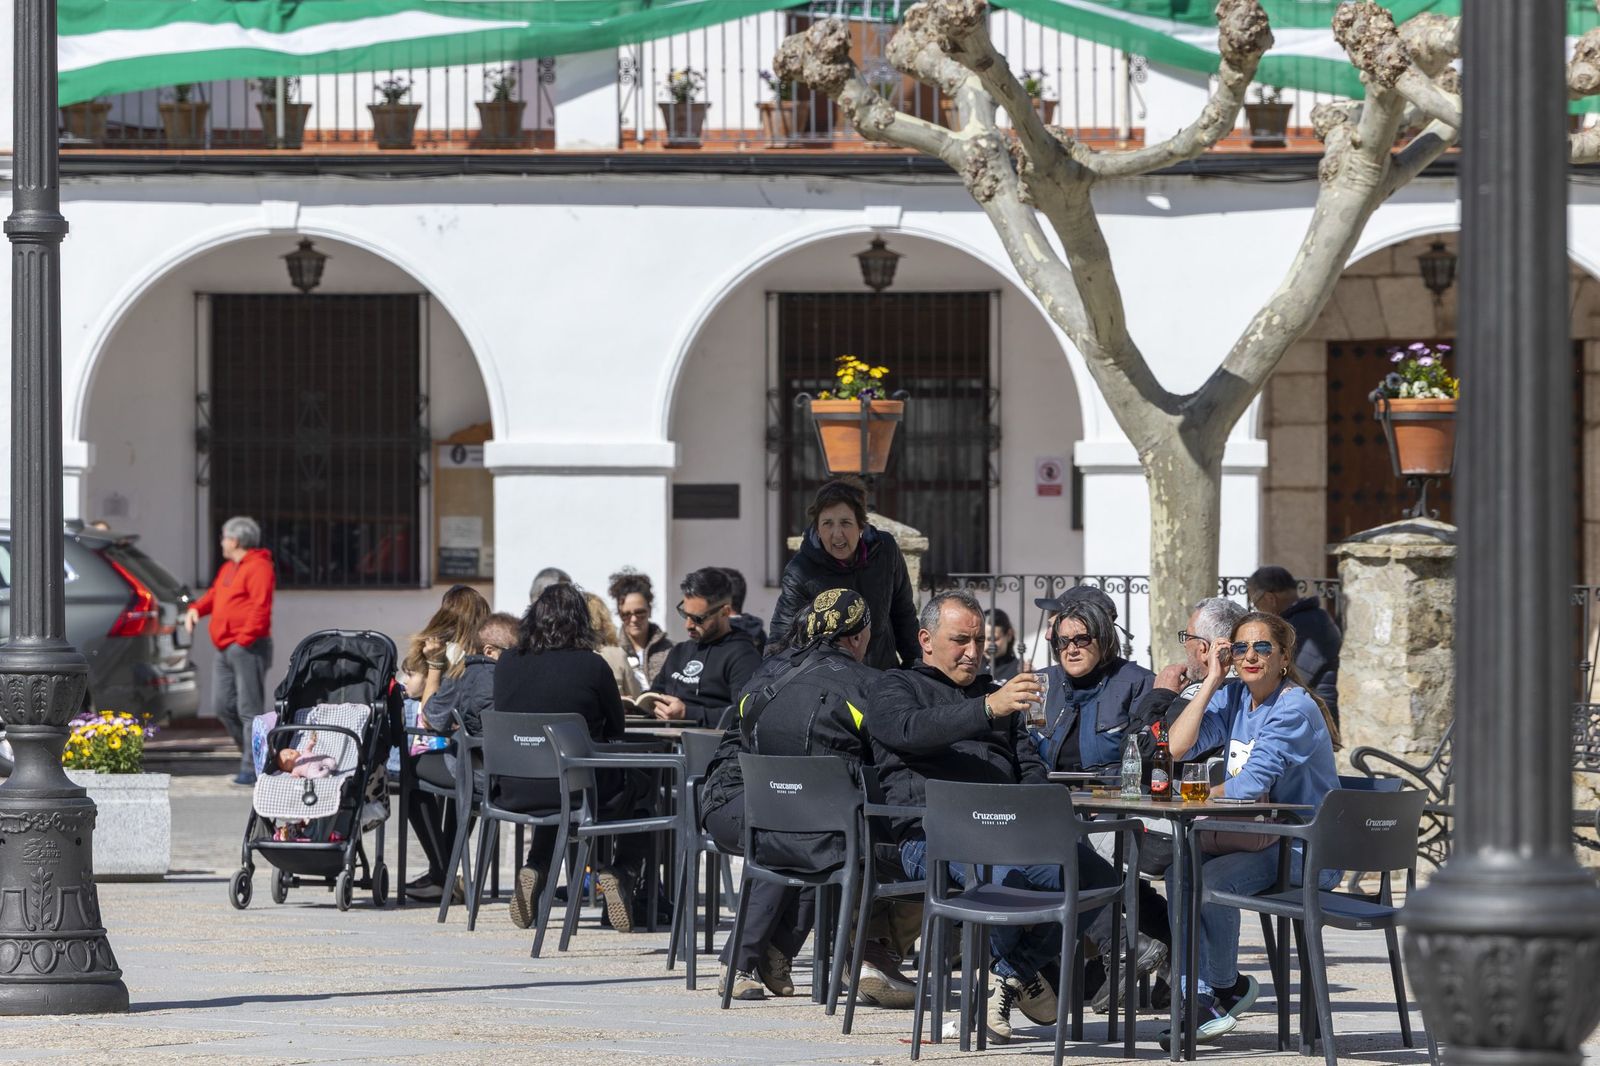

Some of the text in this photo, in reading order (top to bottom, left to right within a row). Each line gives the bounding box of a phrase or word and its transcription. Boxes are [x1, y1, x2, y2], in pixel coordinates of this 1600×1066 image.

[513, 734, 546, 743] Cruzcampo
[769, 780, 803, 791] Cruzcampo
[972, 811, 1017, 822] Cruzcampo
